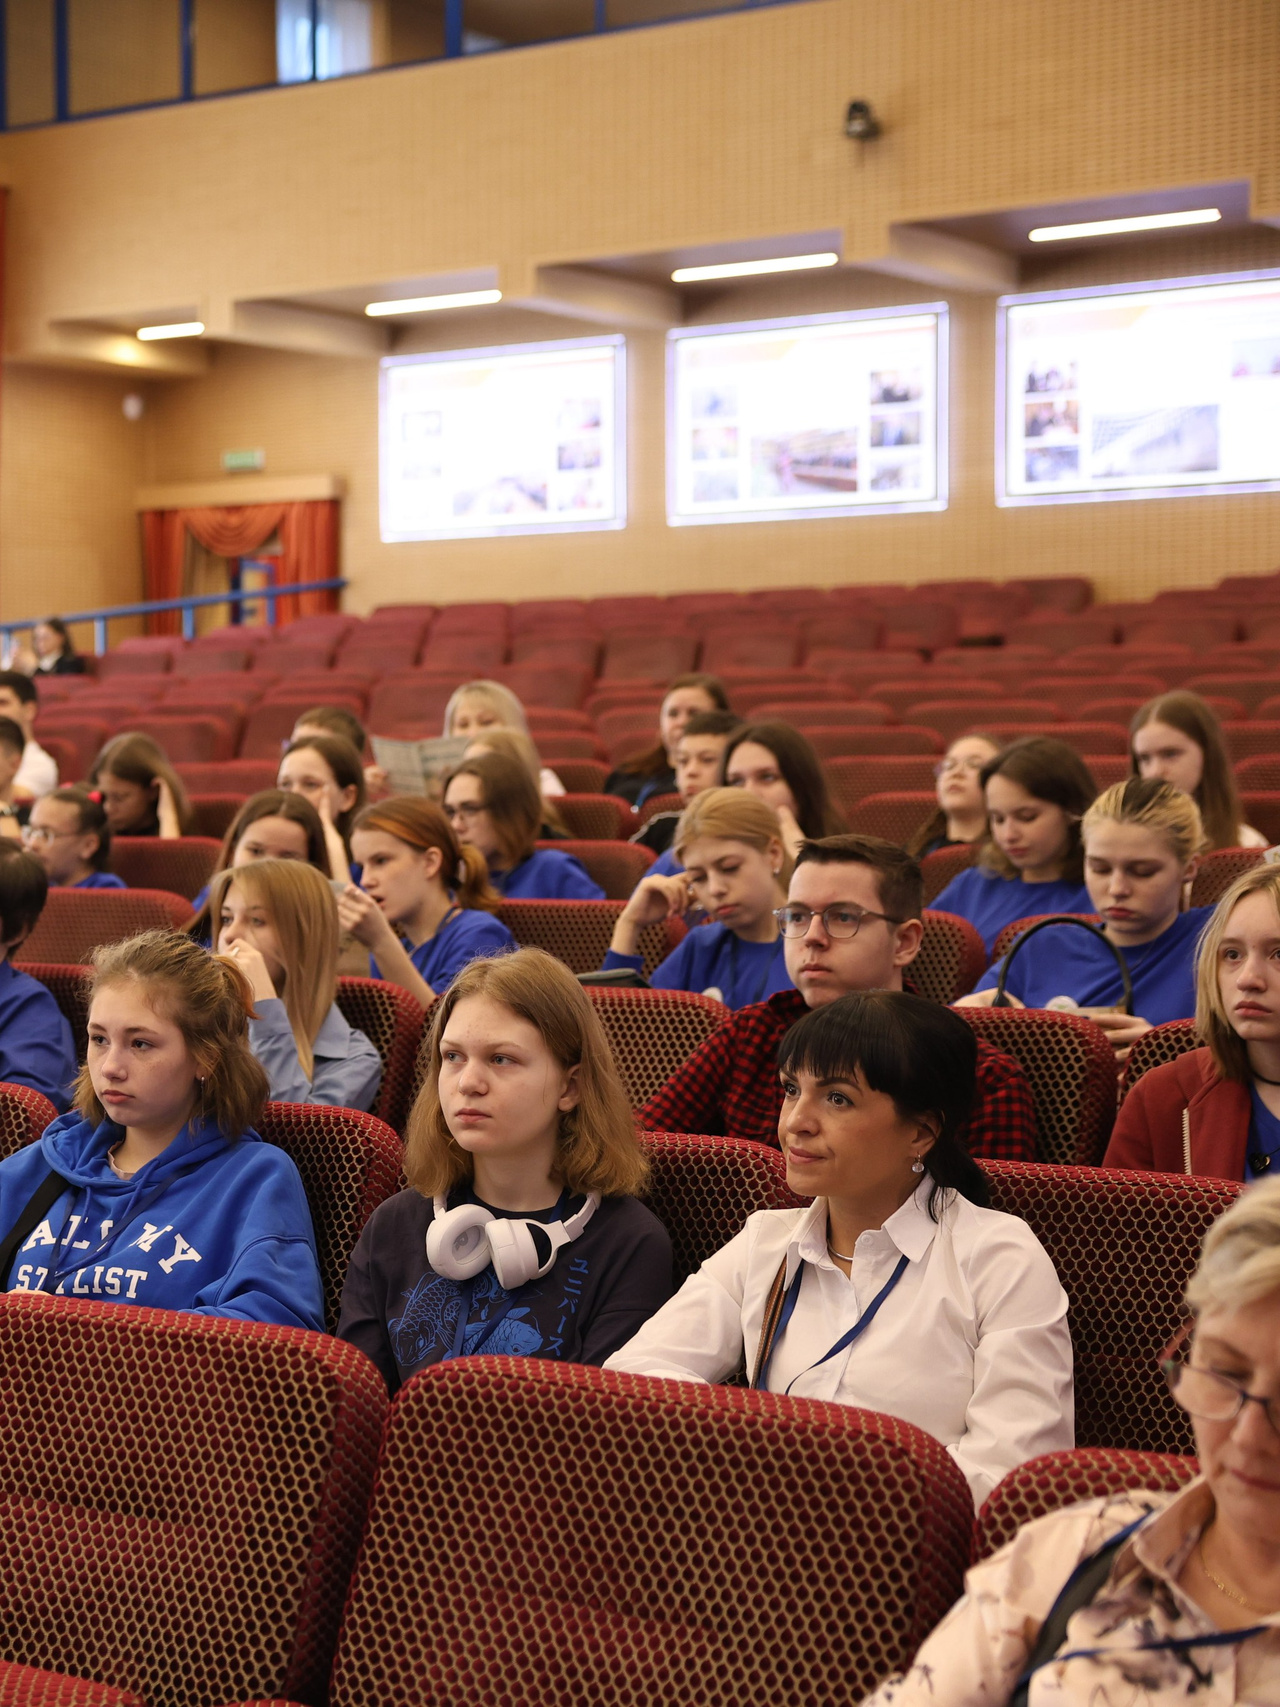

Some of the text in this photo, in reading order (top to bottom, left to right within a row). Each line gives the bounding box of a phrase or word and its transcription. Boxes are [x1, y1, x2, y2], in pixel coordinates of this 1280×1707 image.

[544, 1257, 589, 1357] ユニバース
